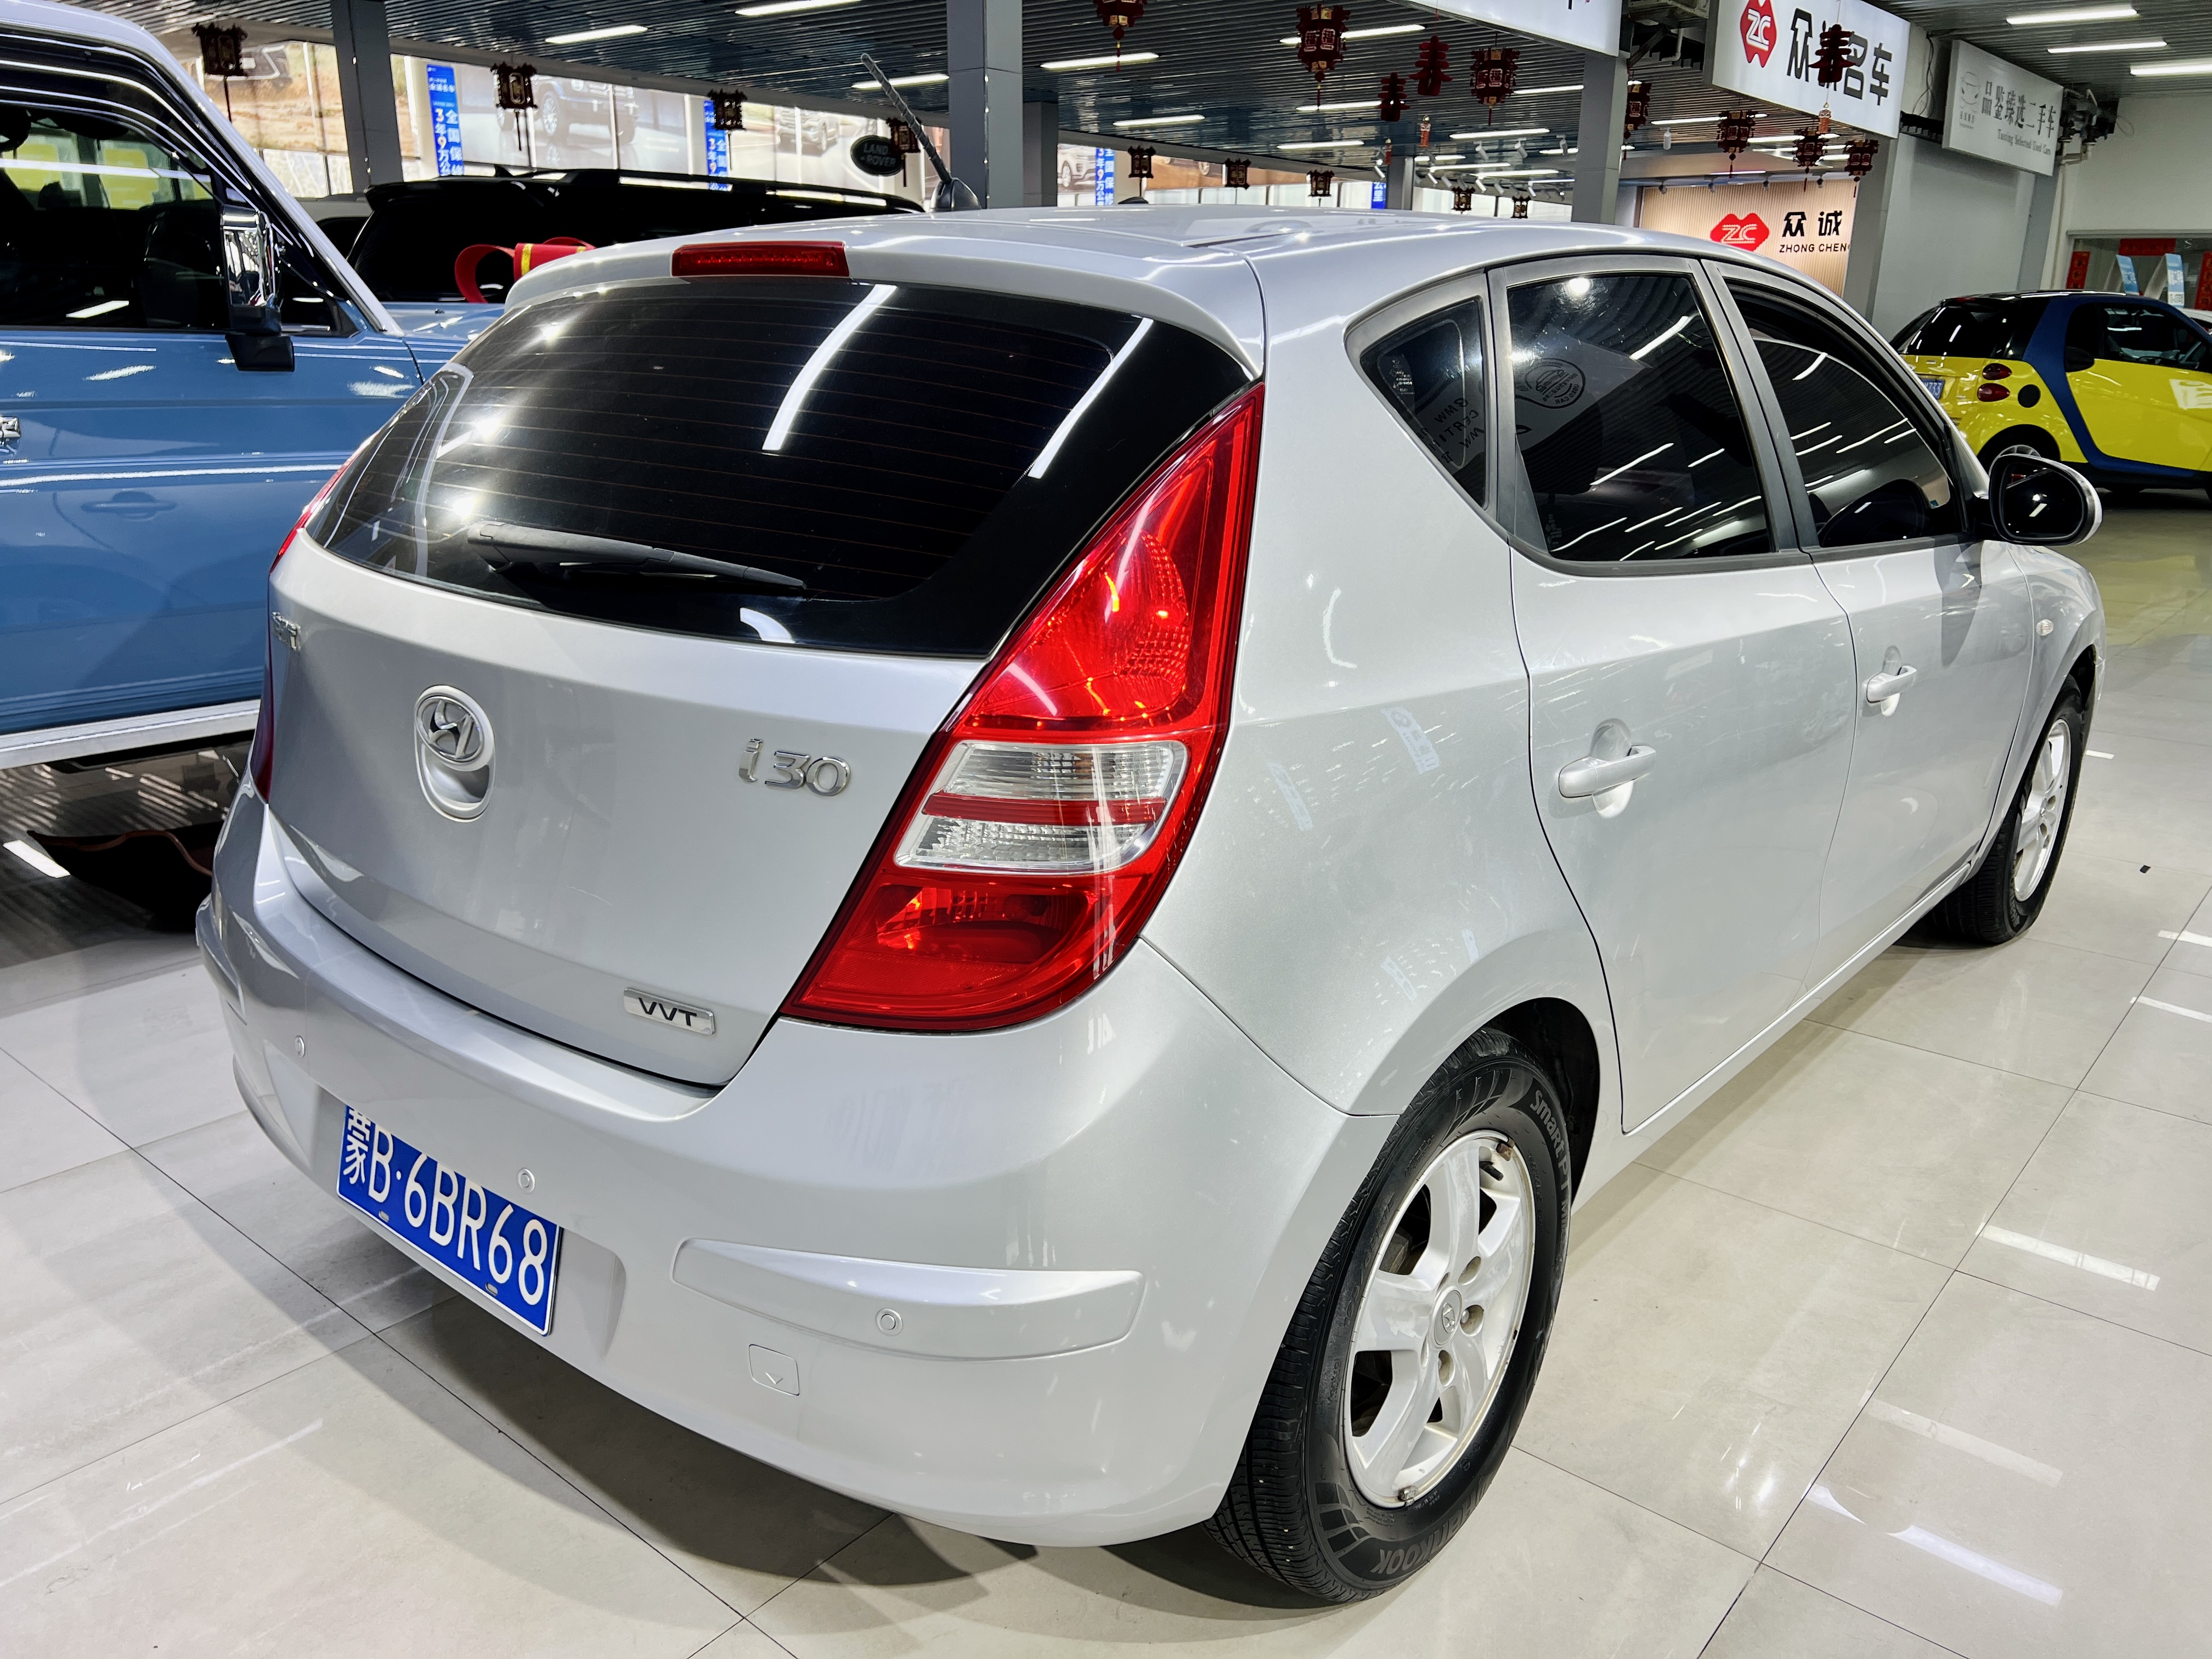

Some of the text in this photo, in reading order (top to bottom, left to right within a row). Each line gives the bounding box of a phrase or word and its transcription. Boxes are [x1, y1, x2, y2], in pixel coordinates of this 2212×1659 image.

[1746, 8, 1771, 52] ZC
[1787, 8, 1893, 106] 众名车
[1720, 223, 1757, 244] ZC
[1782, 210, 1842, 237] 众诚
[1779, 244, 1815, 253] ZHONG
[738, 738, 851, 796] i30
[638, 997, 697, 1026] VVT
